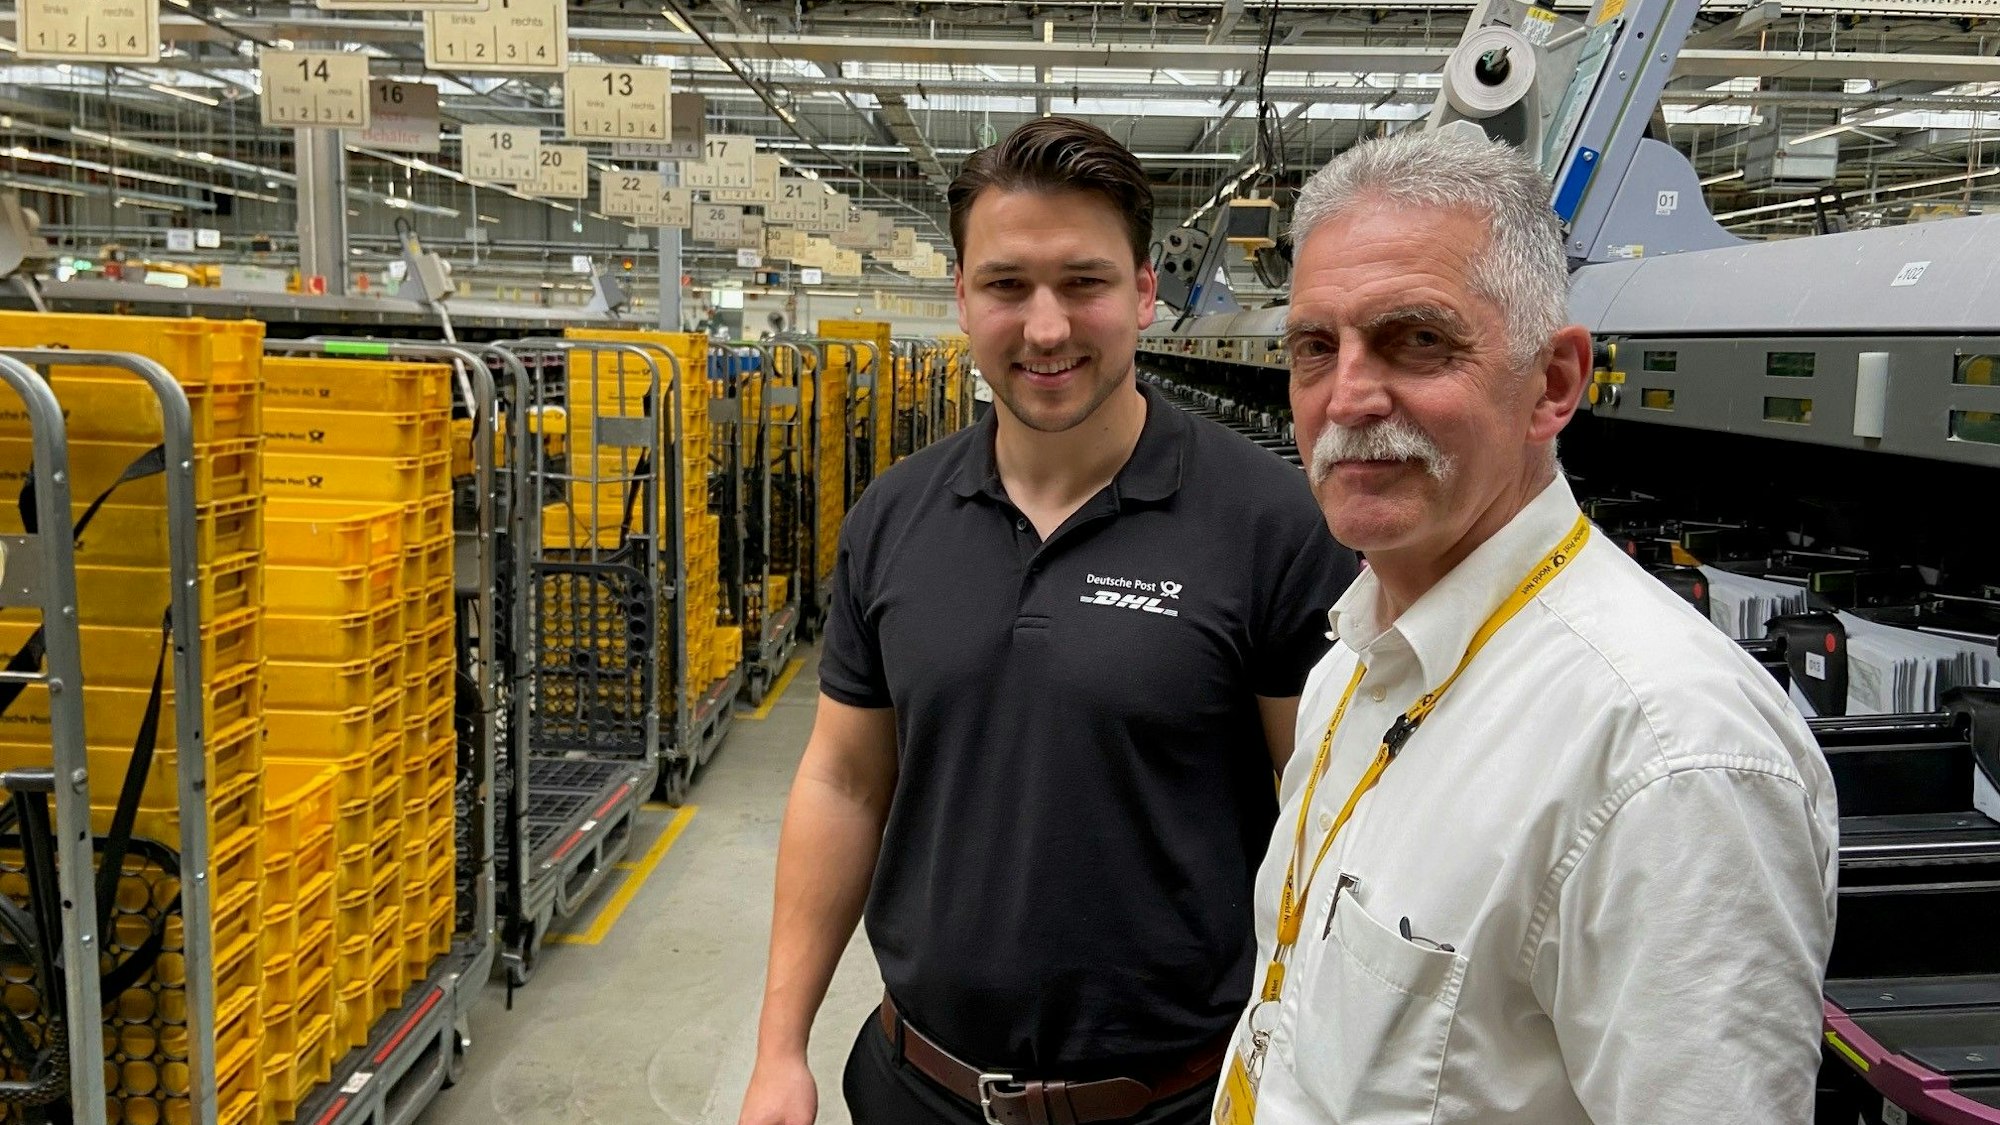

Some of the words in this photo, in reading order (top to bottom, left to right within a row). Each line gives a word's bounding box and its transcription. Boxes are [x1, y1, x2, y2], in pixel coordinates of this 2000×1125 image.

[38, 32, 45, 46] 1
[67, 33, 77, 47] 2
[98, 34, 107, 48] 3
[127, 35, 137, 48] 4
[447, 42, 454, 56] 1
[475, 43, 486, 57] 2
[507, 44, 517, 58] 3
[536, 45, 546, 59] 4
[298, 59, 330, 82] 14
[602, 72, 633, 96] 13
[378, 84, 404, 104] 16
[279, 107, 285, 118] 1
[301, 107, 309, 119] 2
[325, 108, 332, 120] 3
[346, 110, 355, 120] 4
[583, 120, 589, 132] 1
[604, 121, 612, 133] 2
[626, 122, 635, 134] 3
[648, 123, 657, 134] 4
[490, 132, 513, 150] 18
[685, 144, 694, 153] 4
[706, 140, 729, 158] 17
[541, 150, 563, 167] 20
[622, 176, 641, 191] 22
[785, 184, 803, 199] 21
[662, 190, 672, 203] 4
[1659, 194, 1675, 207] 01
[709, 208, 727, 221] 26
[848, 212, 861, 223] 25
[1086, 573, 1133, 588] Deutsche
[1134, 579, 1157, 592] Post
[1532, 564, 1553, 585] World
[1521, 582, 1535, 595] Net
[1092, 590, 1166, 614] DHL
